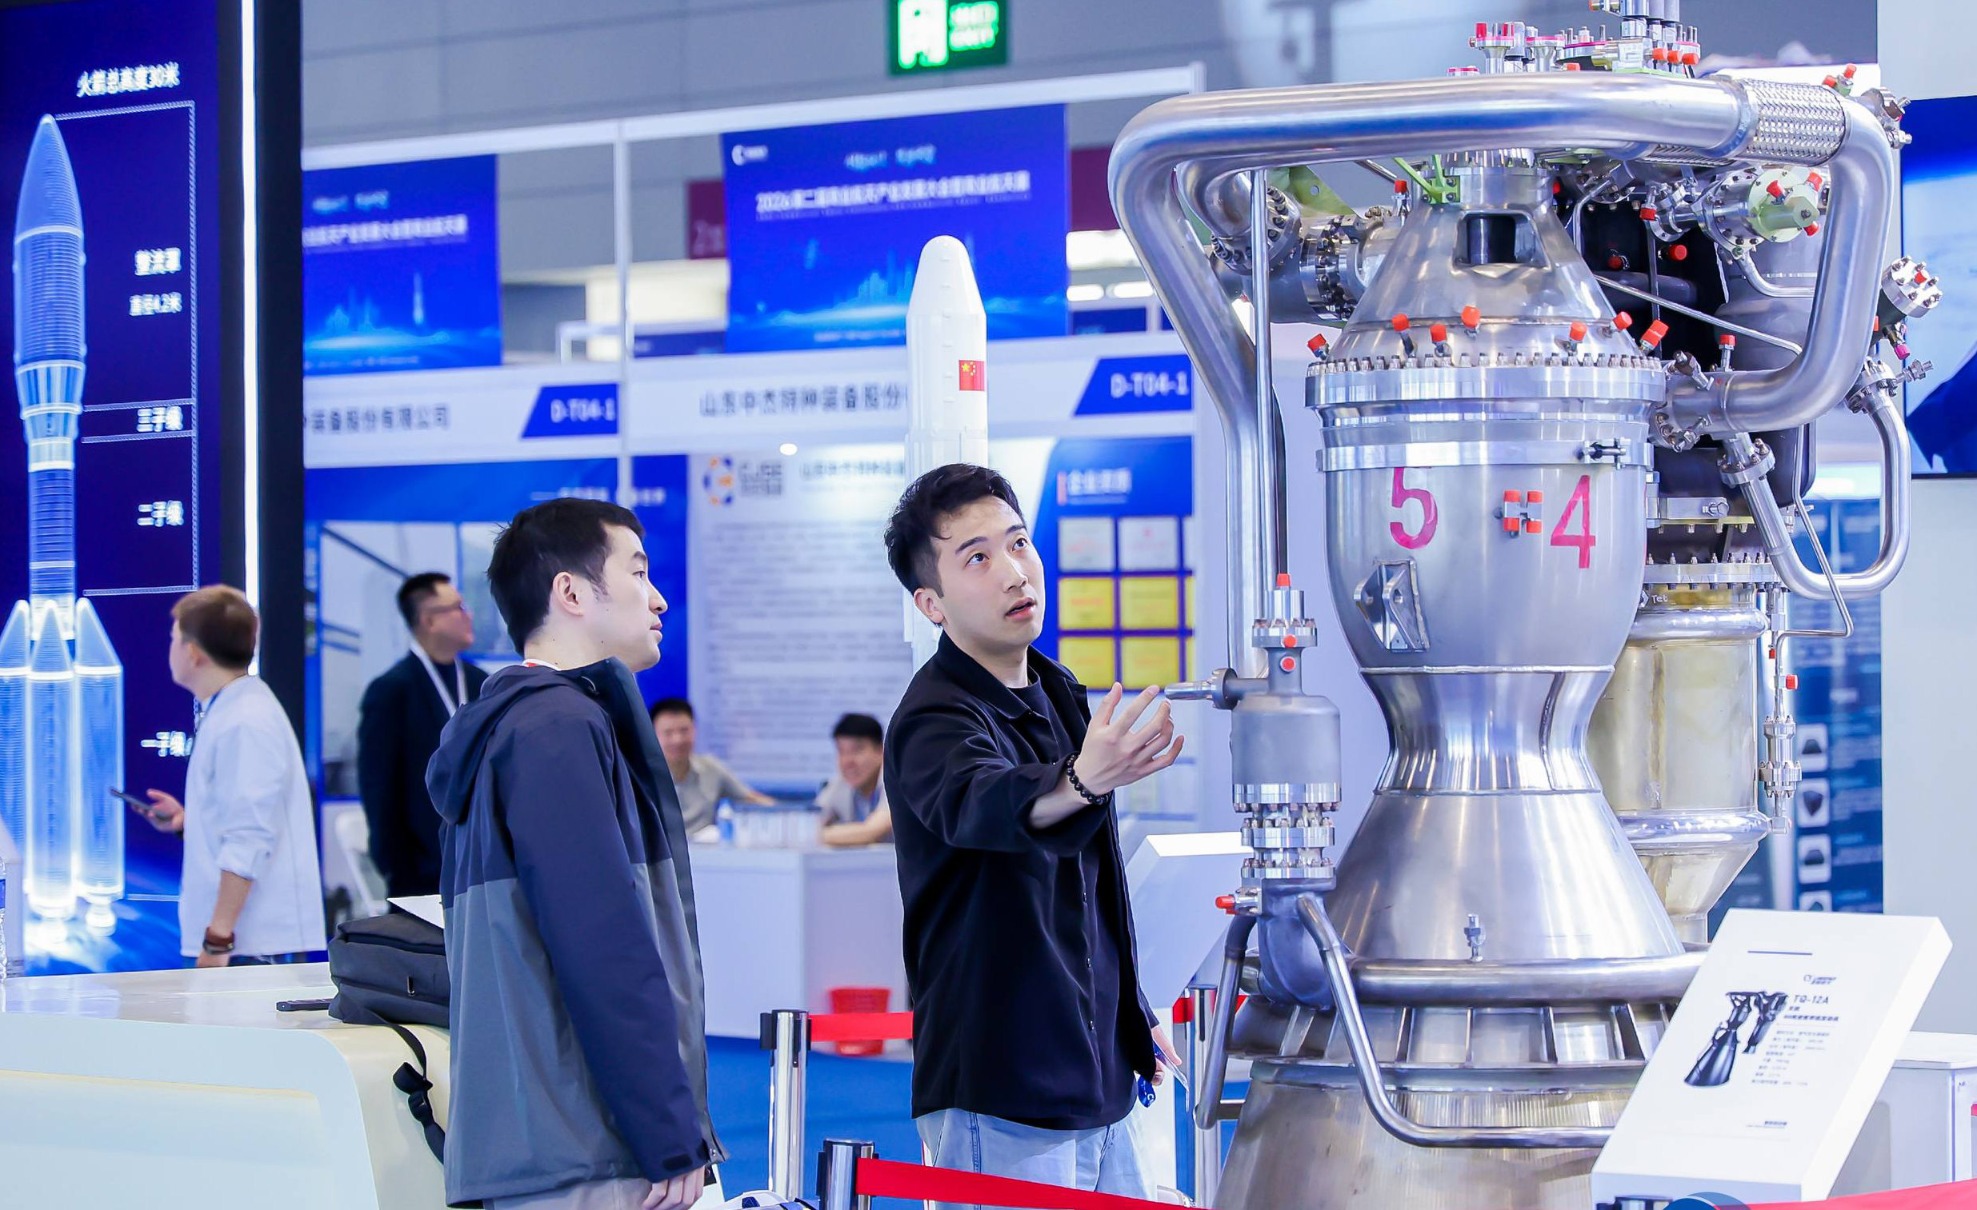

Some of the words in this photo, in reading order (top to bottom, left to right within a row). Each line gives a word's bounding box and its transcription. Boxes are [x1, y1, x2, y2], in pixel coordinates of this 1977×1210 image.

[700, 381, 908, 417] 山东中杰特种装备股份
[1109, 371, 1189, 399] D-T04-1
[136, 405, 183, 433] 三子级
[303, 403, 448, 434] 装备股份有限公司
[550, 398, 614, 423] D-T04-1
[136, 500, 184, 527] 二子级
[1390, 466, 1438, 549] 5
[1550, 474, 1596, 569] 4
[1793, 994, 1829, 1005] TQ-12A
